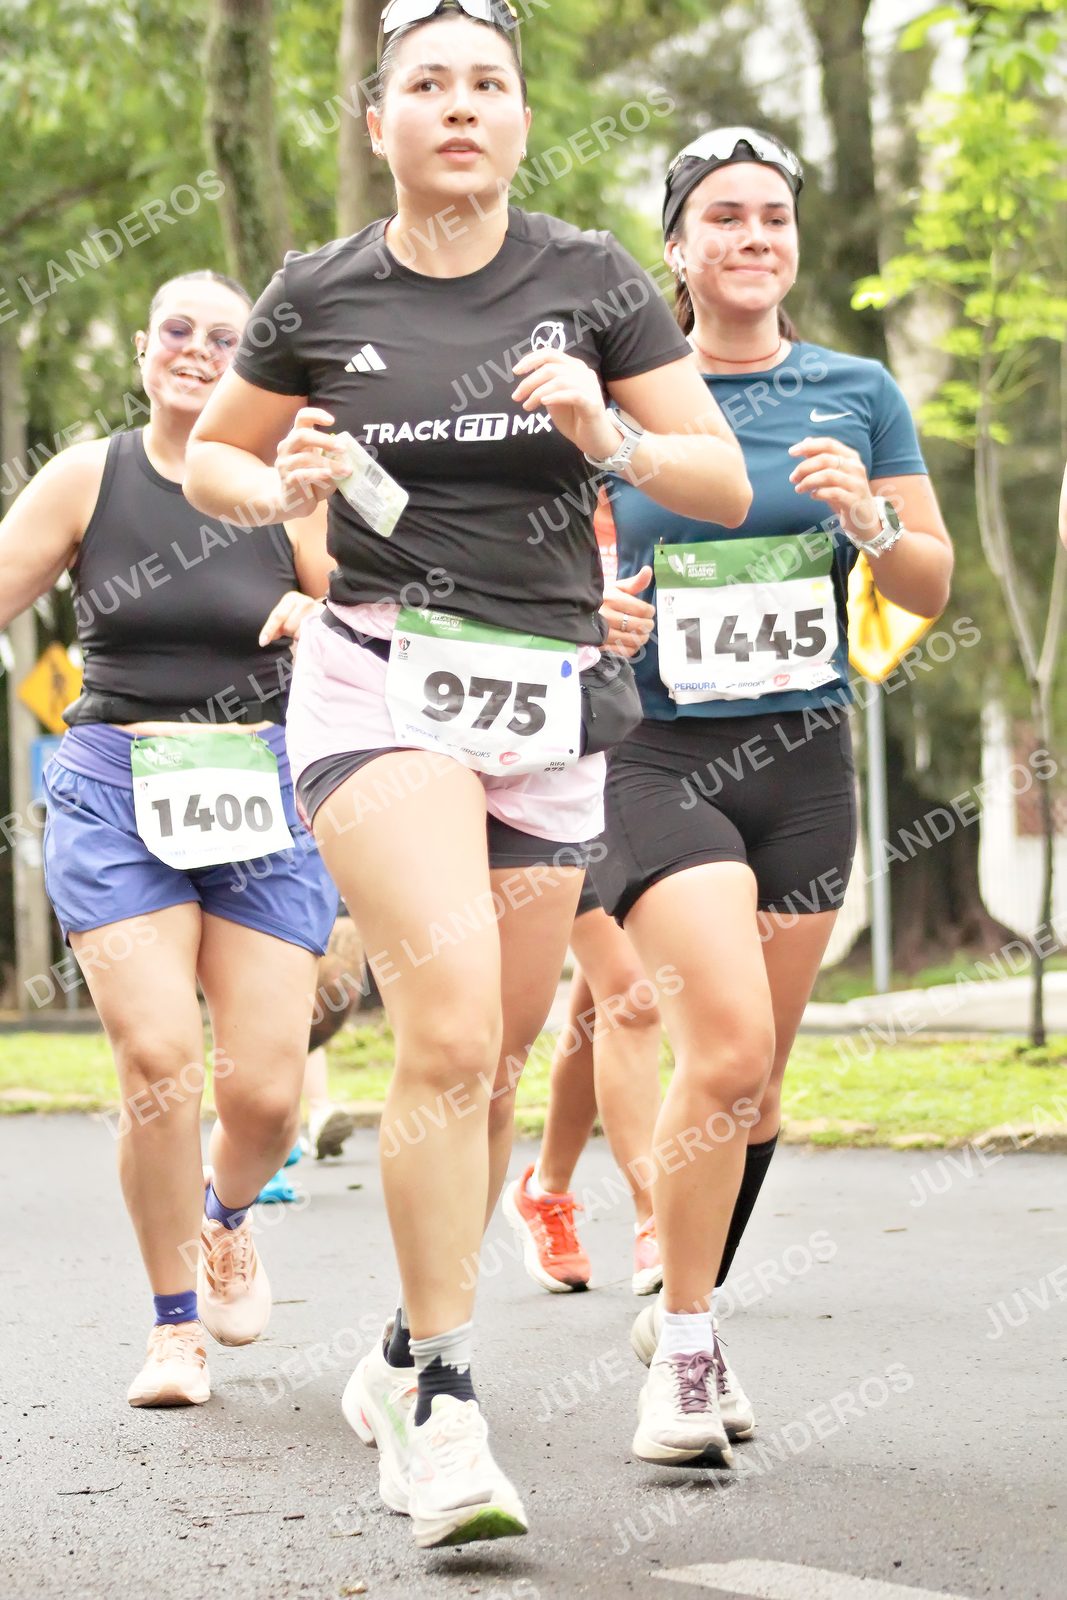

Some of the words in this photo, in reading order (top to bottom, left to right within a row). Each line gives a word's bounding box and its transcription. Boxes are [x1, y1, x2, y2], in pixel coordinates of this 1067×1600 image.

[363, 419, 451, 444] TRACK
[458, 415, 505, 439] FIT
[512, 412, 552, 436] MX
[676, 608, 826, 664] 1445
[421, 670, 547, 736] 975
[674, 682, 717, 690] PERDURA
[151, 793, 273, 837] 1400
